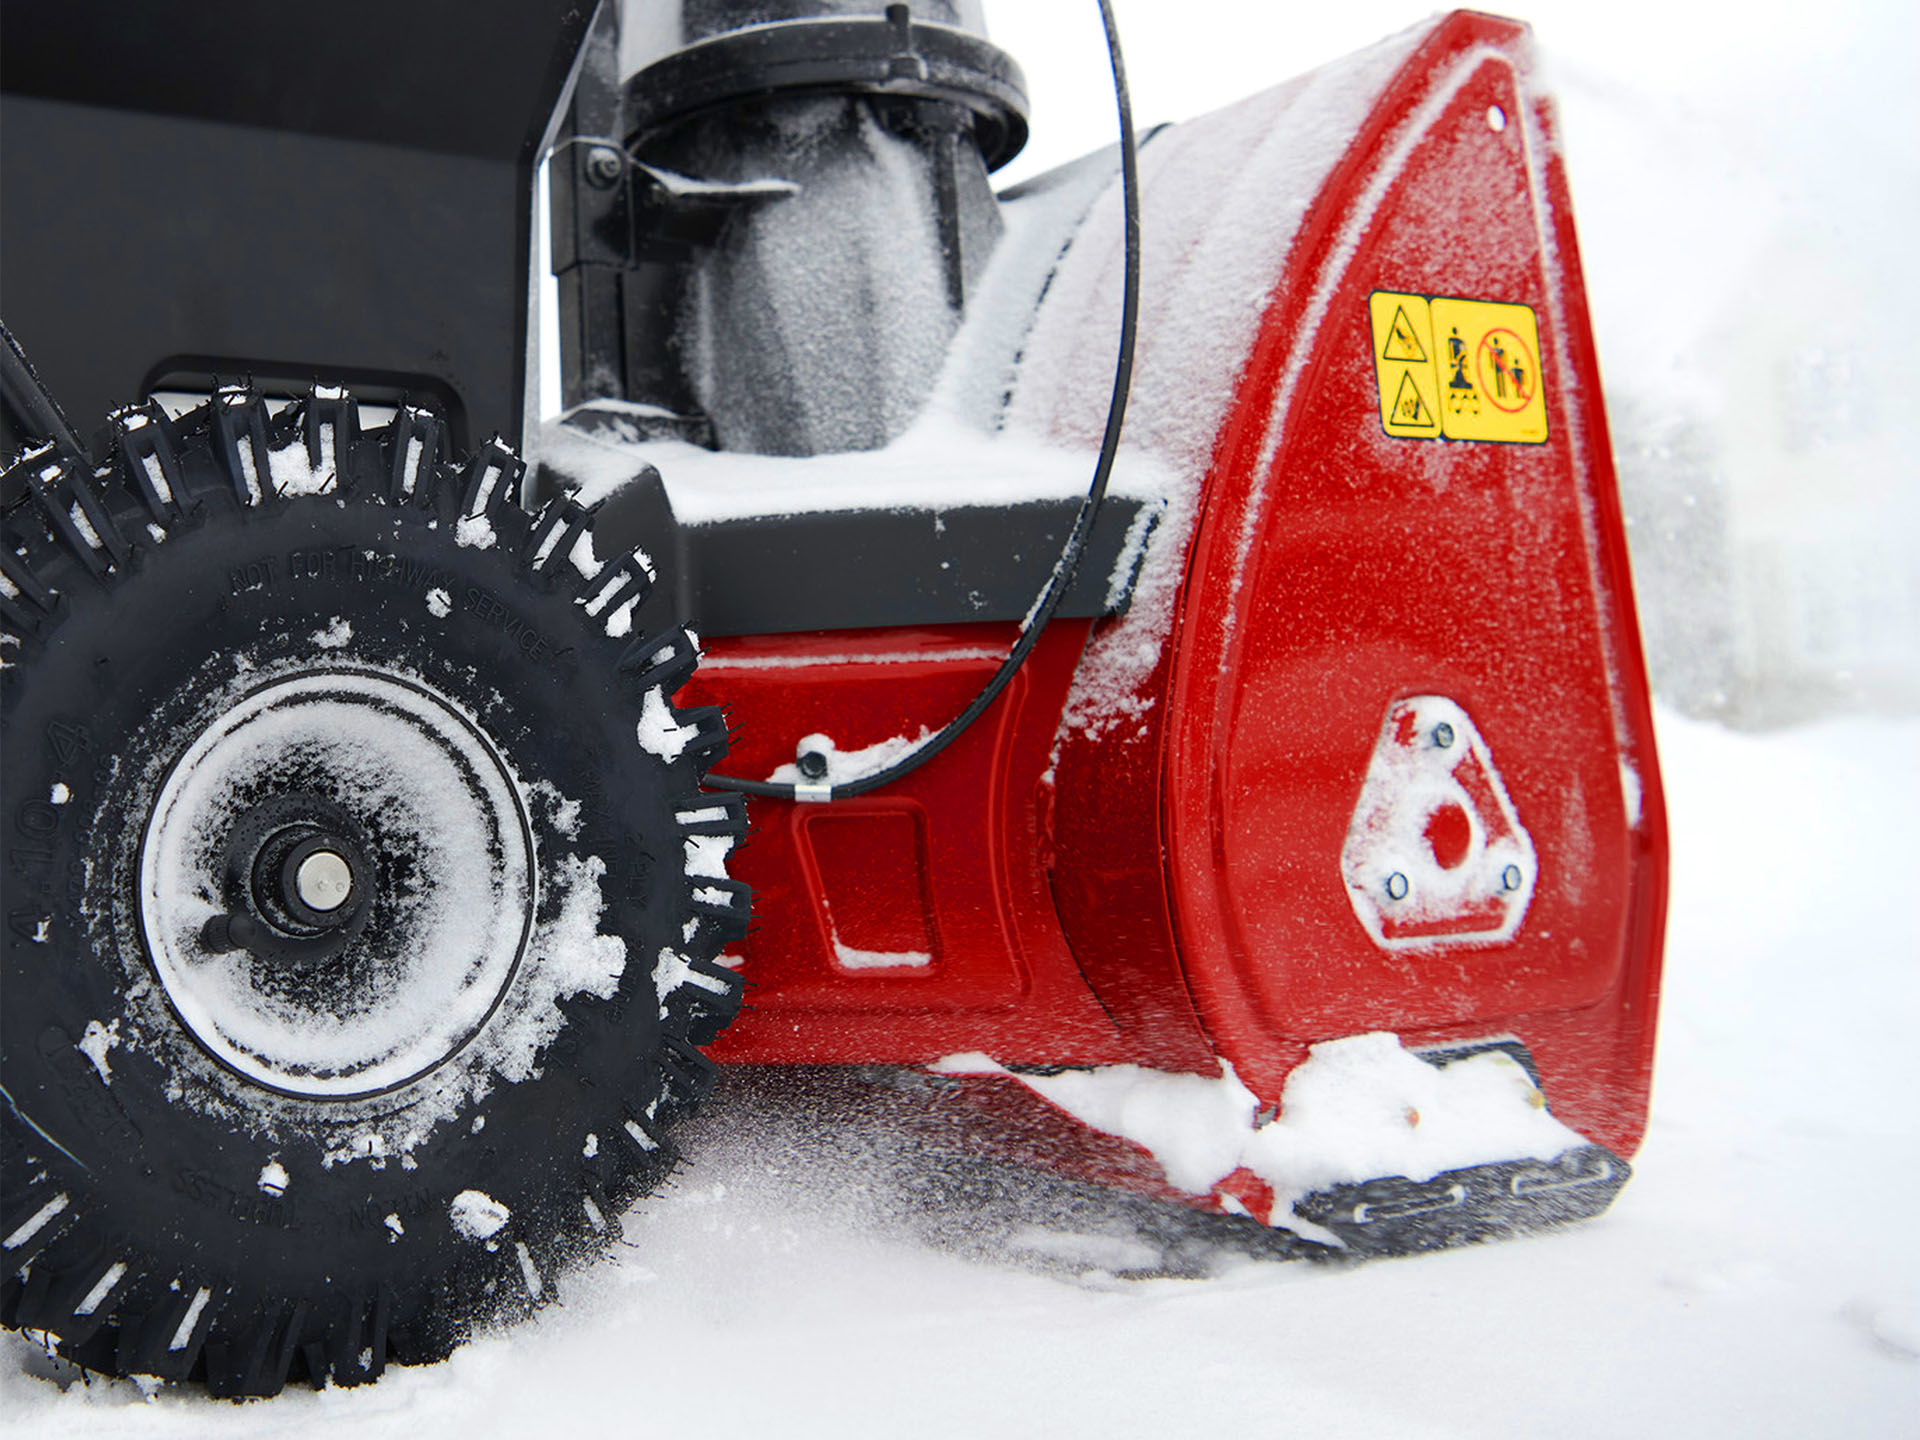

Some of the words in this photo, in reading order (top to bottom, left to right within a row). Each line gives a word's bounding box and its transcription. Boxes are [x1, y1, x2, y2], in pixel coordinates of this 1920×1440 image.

[229, 555, 278, 592] NOT
[289, 551, 336, 580] FOR
[350, 551, 457, 593] HIGHWAY
[463, 587, 548, 661] SERVICE
